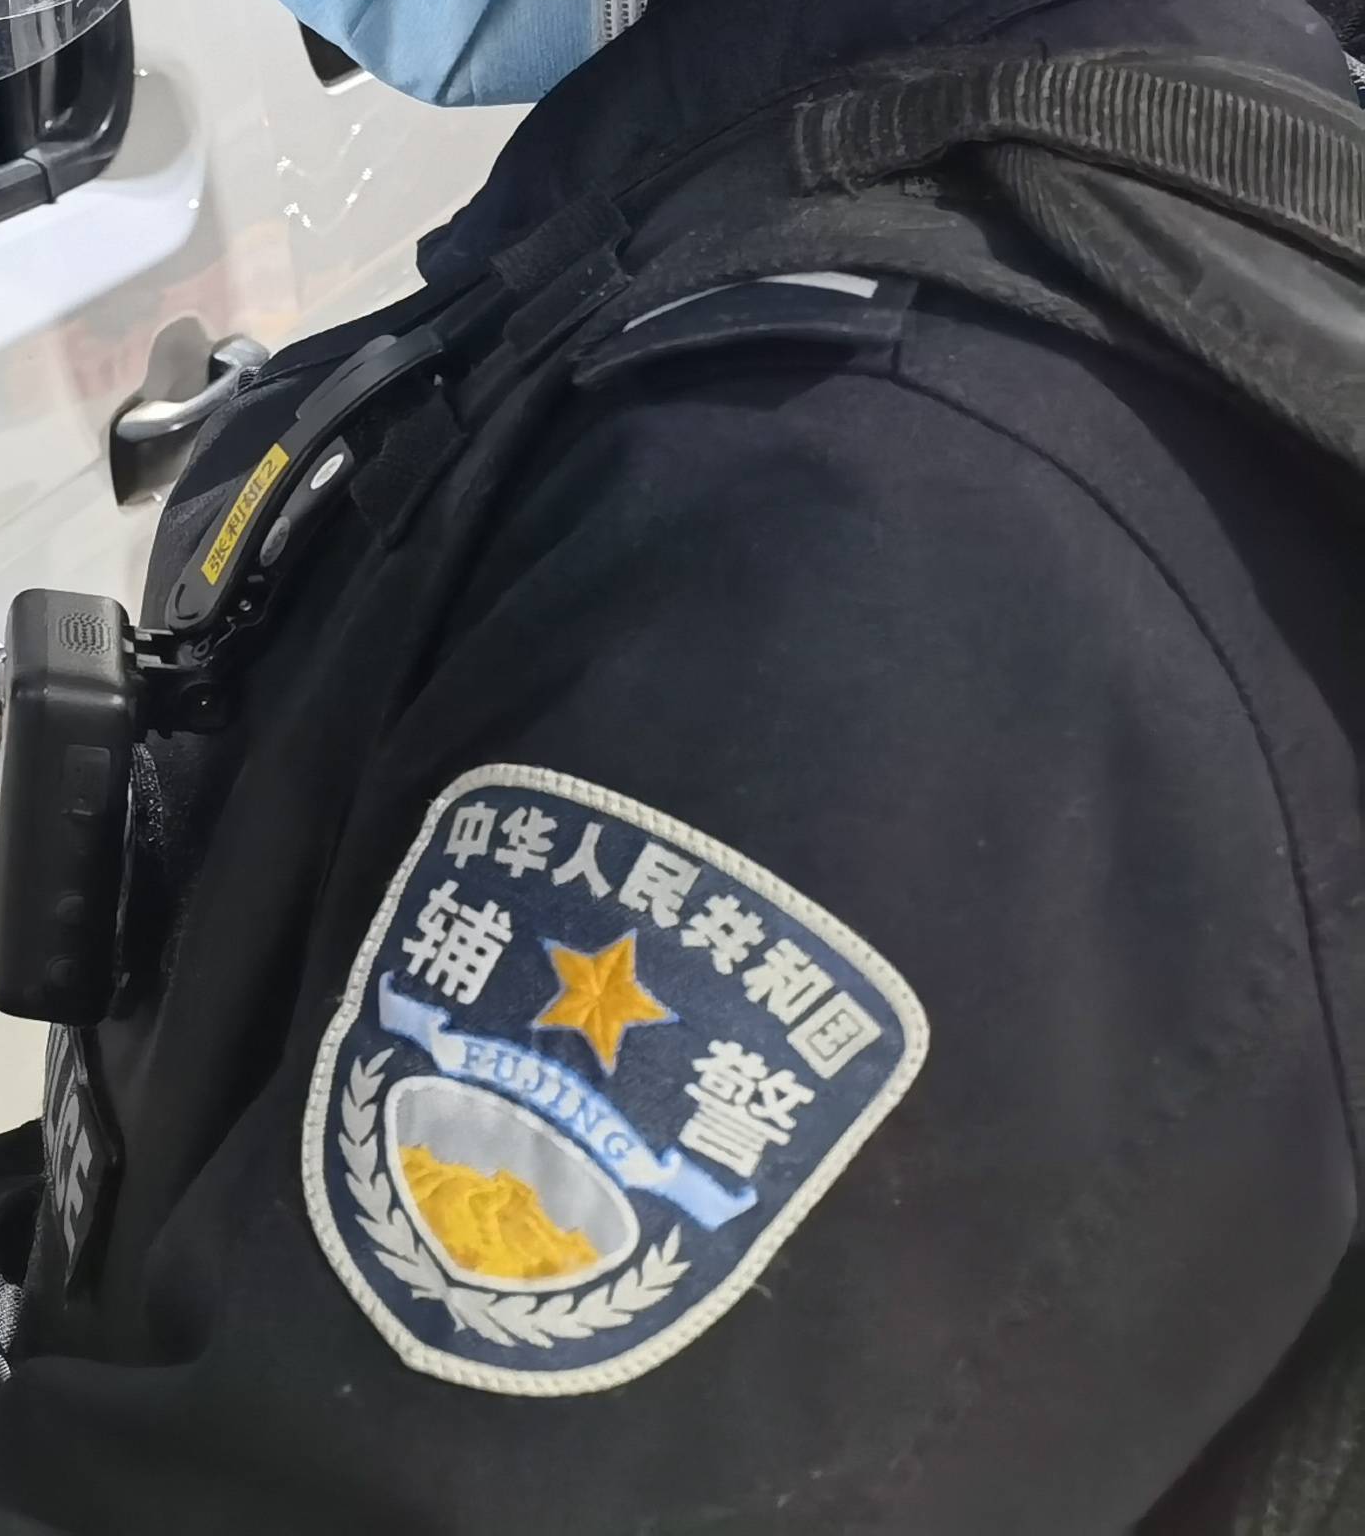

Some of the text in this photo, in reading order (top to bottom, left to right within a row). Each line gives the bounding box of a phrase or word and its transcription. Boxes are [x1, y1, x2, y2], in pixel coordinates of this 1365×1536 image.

[441, 800, 881, 1080] 中华人民共和国
[461, 1040, 633, 1160] FUJING
